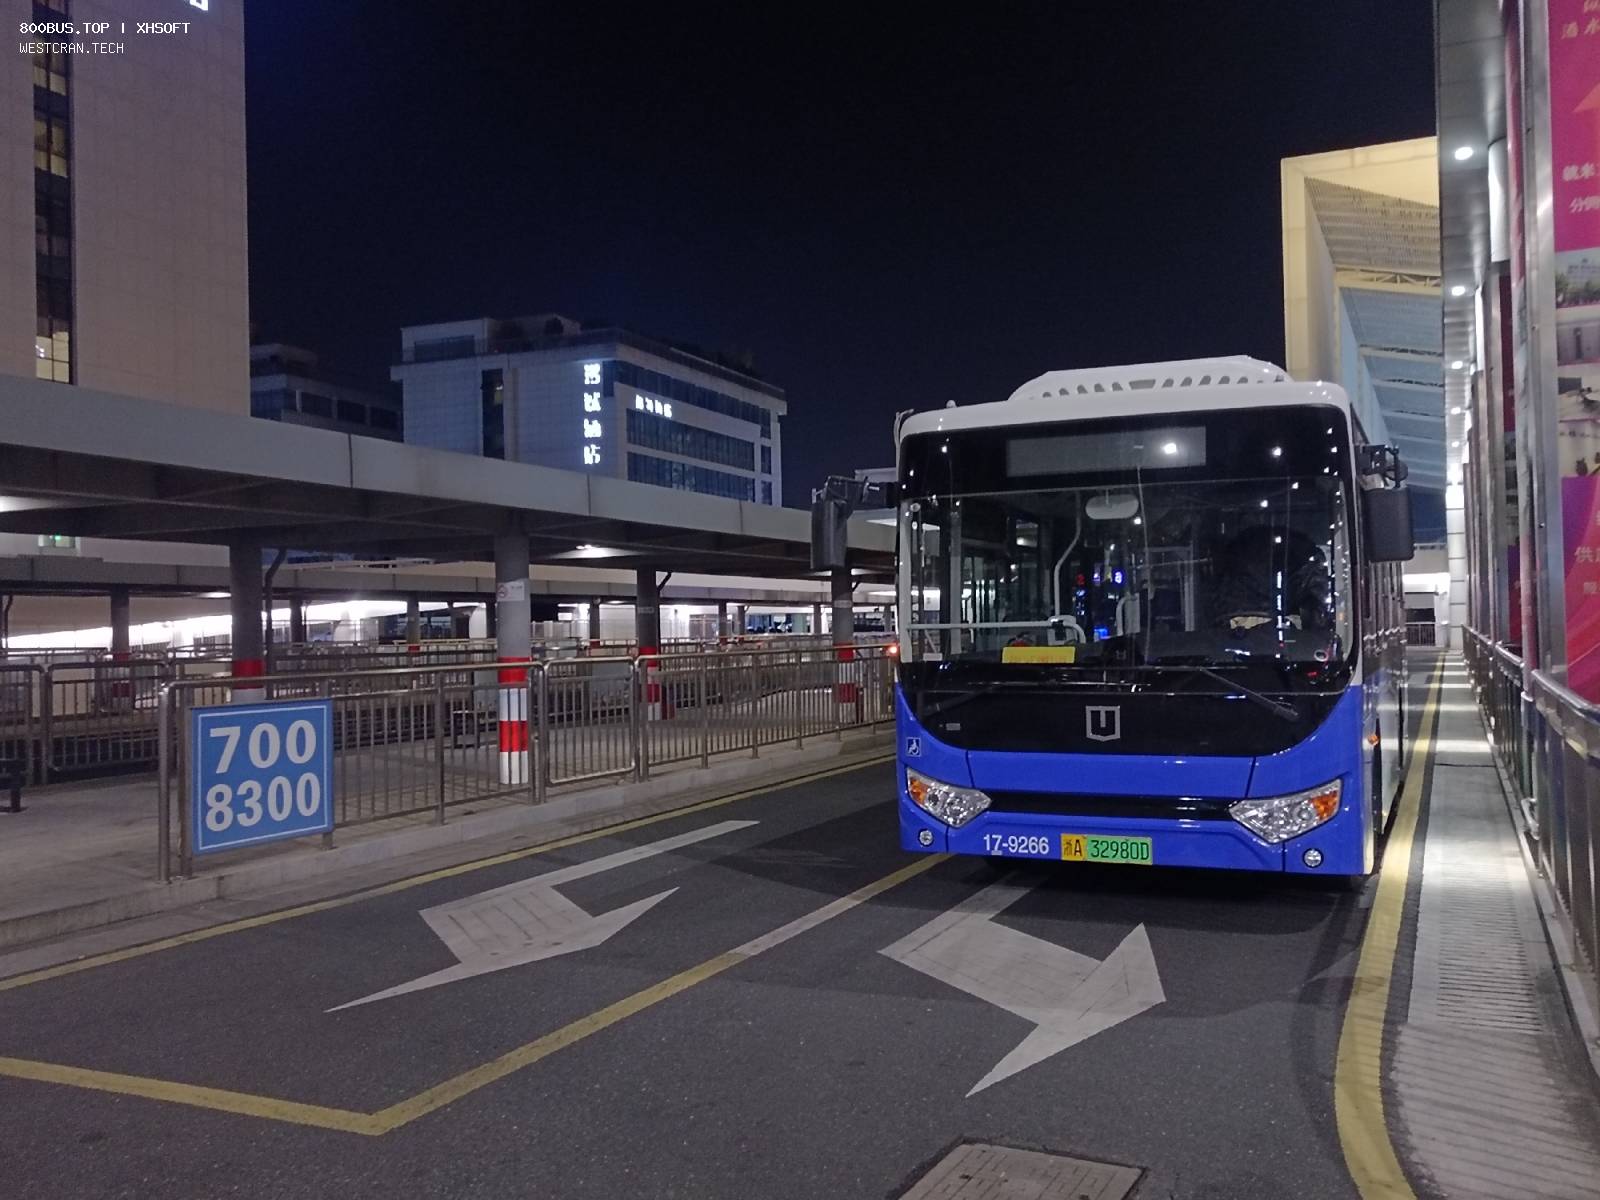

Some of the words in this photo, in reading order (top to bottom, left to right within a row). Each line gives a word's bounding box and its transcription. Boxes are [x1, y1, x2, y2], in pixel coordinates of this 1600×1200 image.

[210, 720, 316, 774] 700
[205, 772, 321, 832] 8300
[983, 834, 1049, 854] 17-9266
